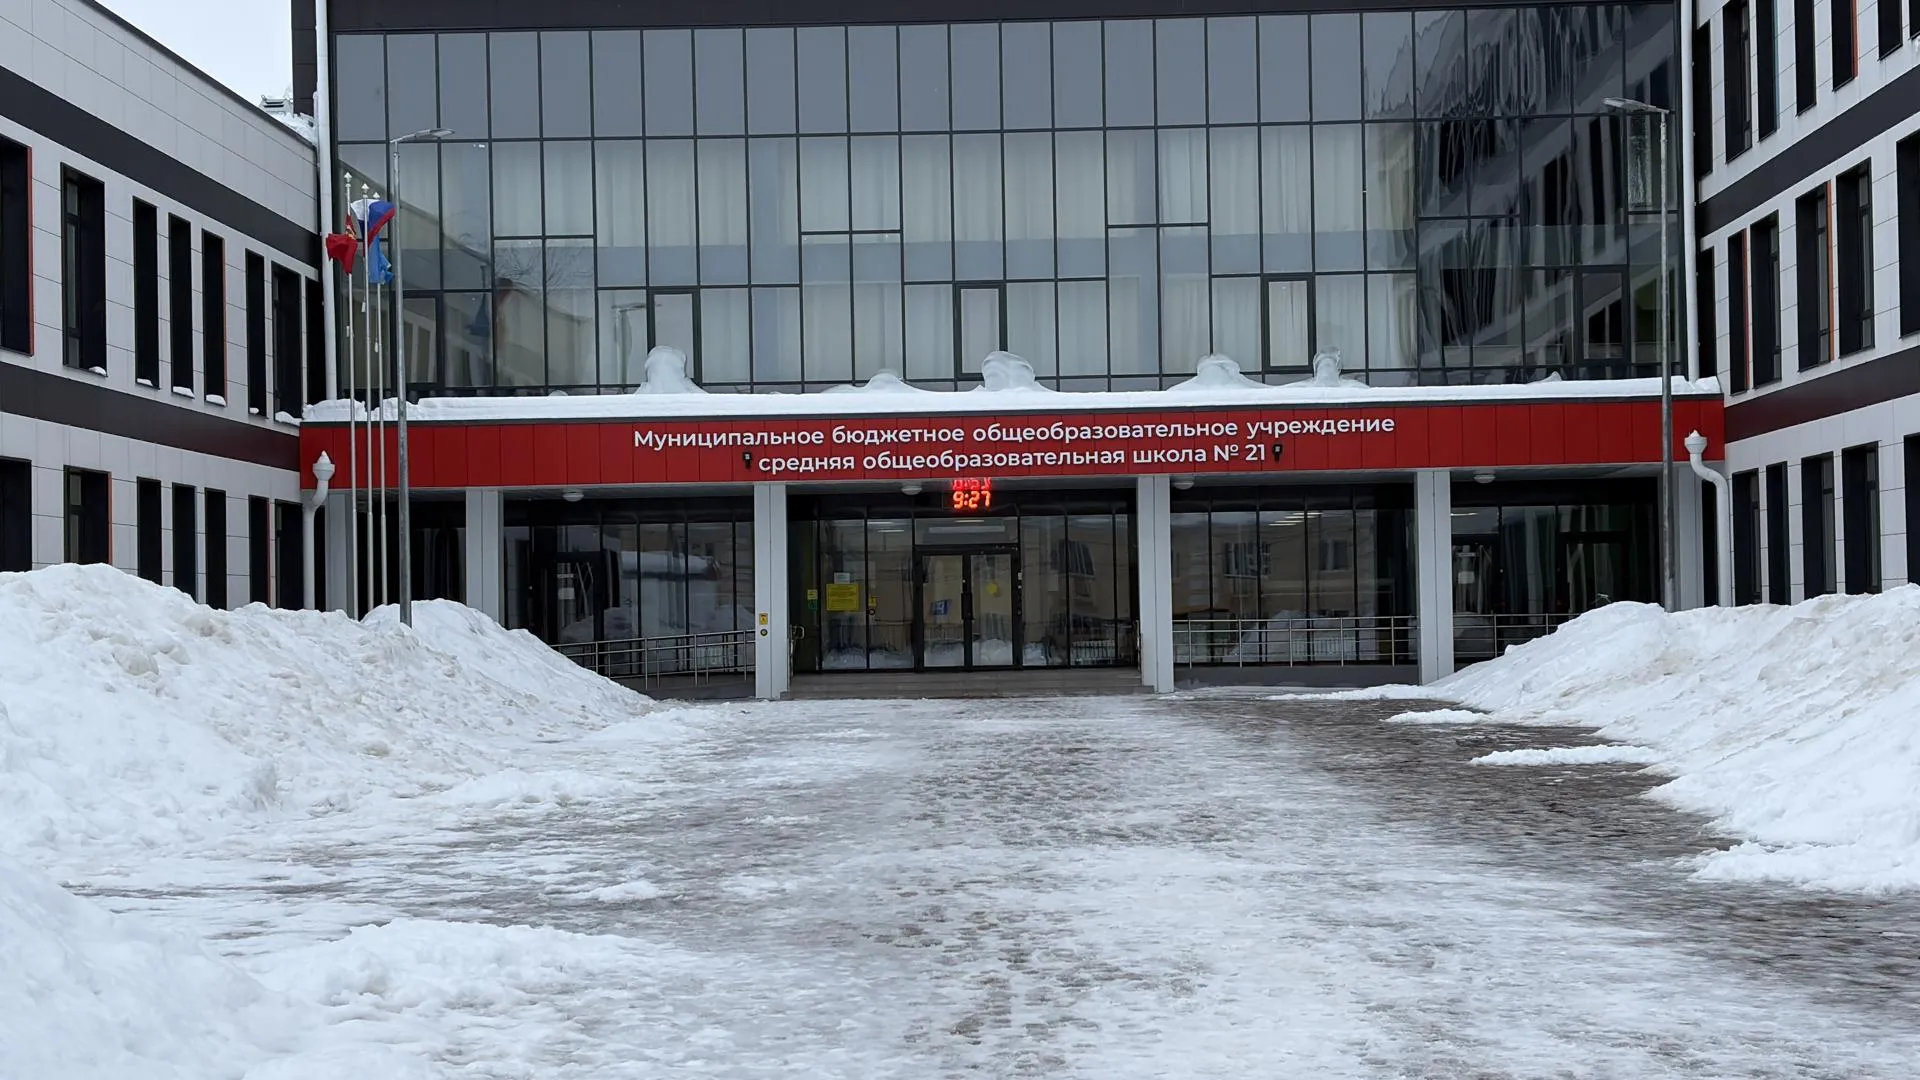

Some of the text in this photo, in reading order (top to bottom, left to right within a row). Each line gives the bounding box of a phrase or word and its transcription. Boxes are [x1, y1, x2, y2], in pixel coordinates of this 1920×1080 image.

[634, 418, 1395, 450] Муниципальное бюджетное общеобразовательное учреждение
[758, 444, 1265, 473] средняя общеобразовательная школа № 21
[953, 490, 991, 509] 9:27
